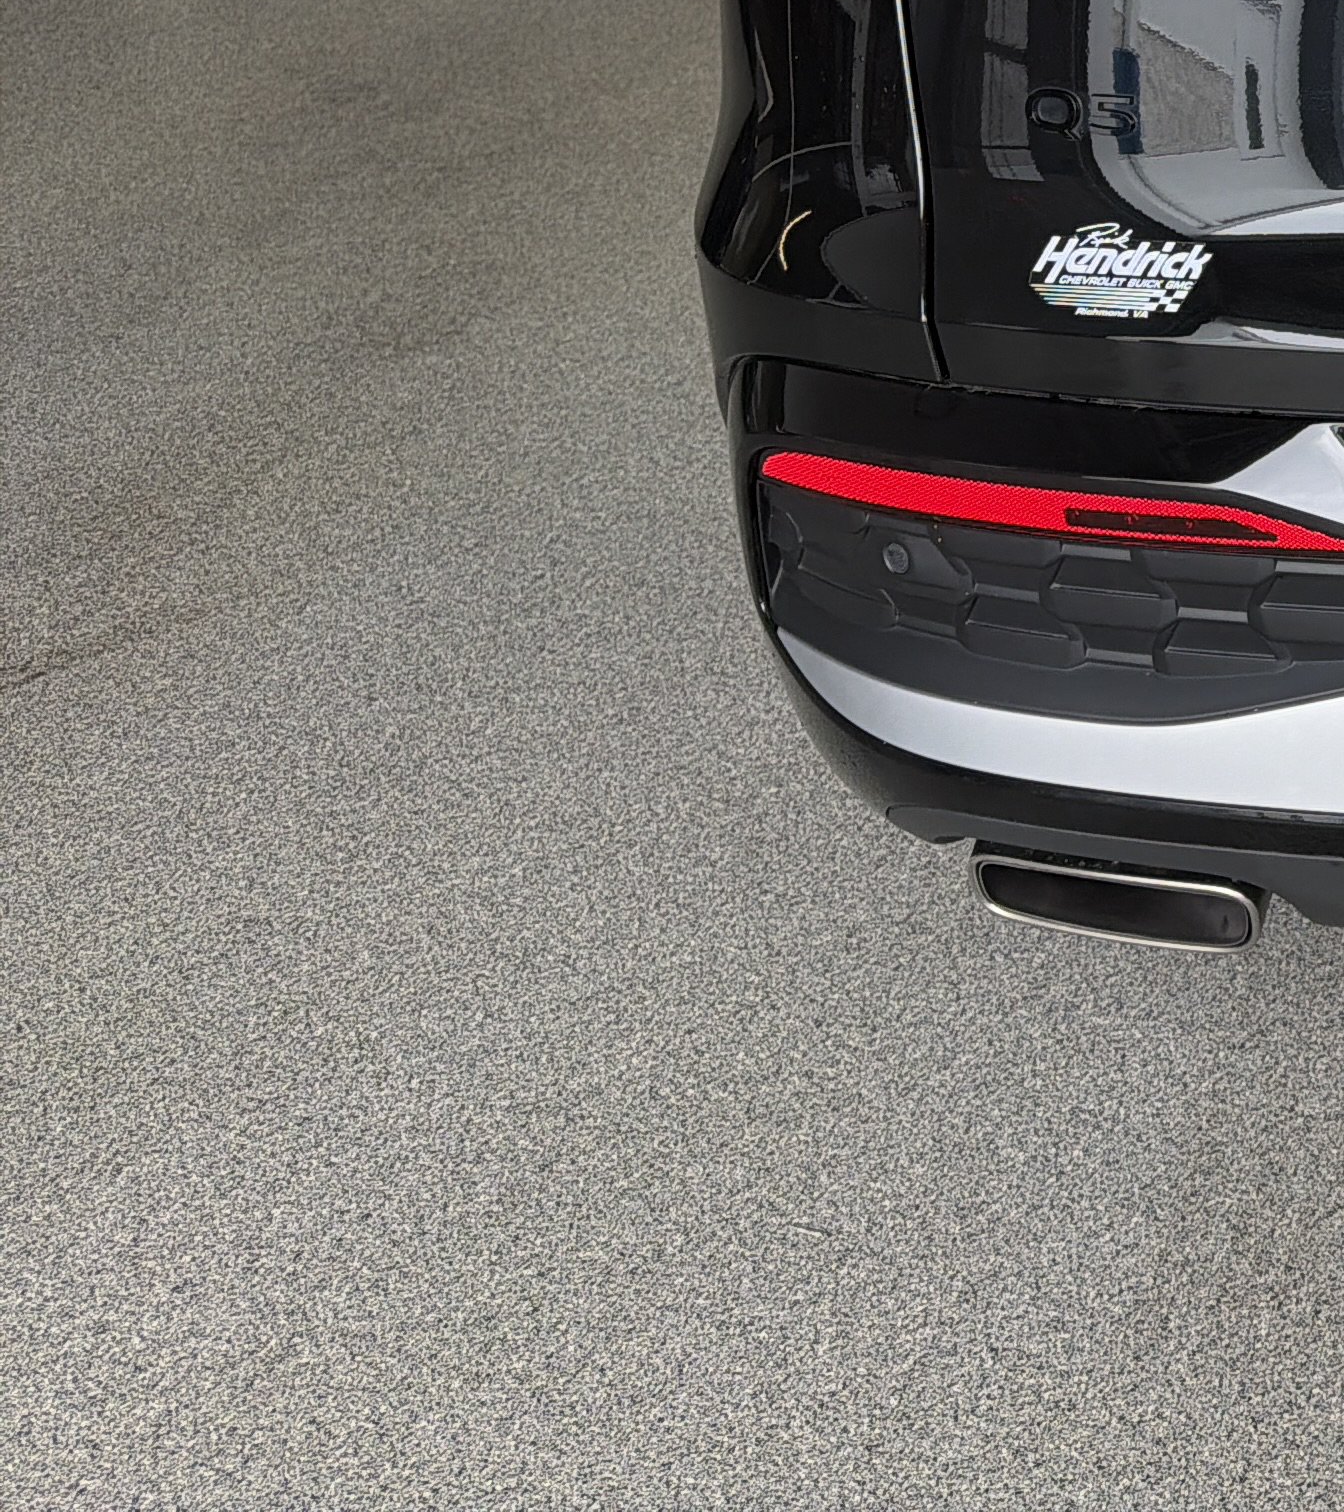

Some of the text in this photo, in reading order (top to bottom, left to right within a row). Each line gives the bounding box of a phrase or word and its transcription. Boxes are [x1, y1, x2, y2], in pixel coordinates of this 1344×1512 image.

[1032, 235, 1214, 284] Hendrick
[1059, 275, 1194, 291] CHEVROLET BUICK GMC
[1132, 310, 1149, 319] VA
